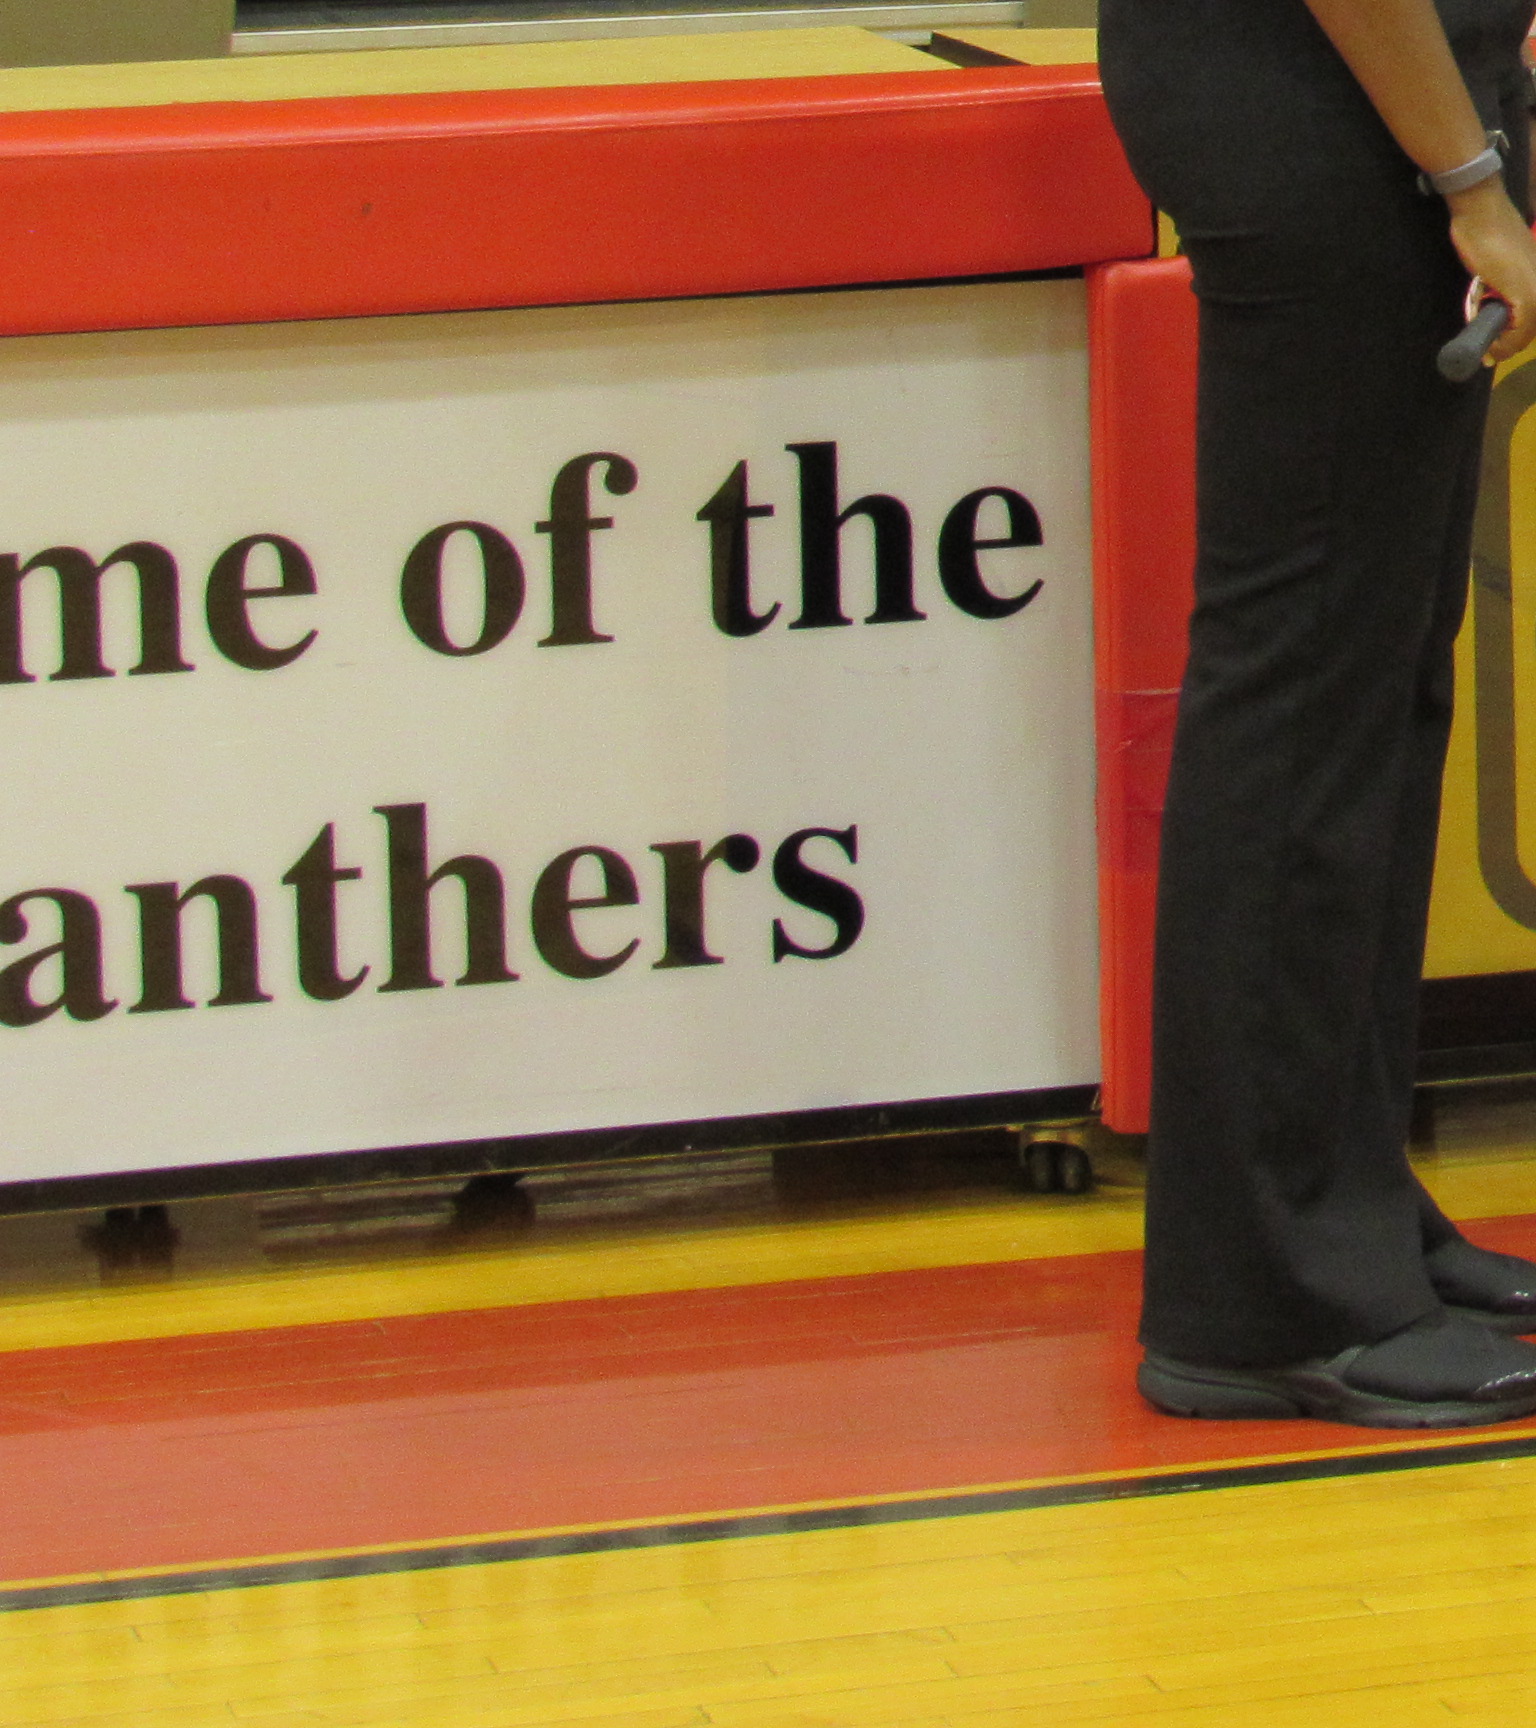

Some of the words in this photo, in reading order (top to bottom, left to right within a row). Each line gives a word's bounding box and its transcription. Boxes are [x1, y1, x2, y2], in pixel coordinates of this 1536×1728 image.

[0, 531, 320, 684] me
[398, 450, 639, 658] of
[695, 440, 1046, 639] the
[0, 801, 867, 1027] anthers
